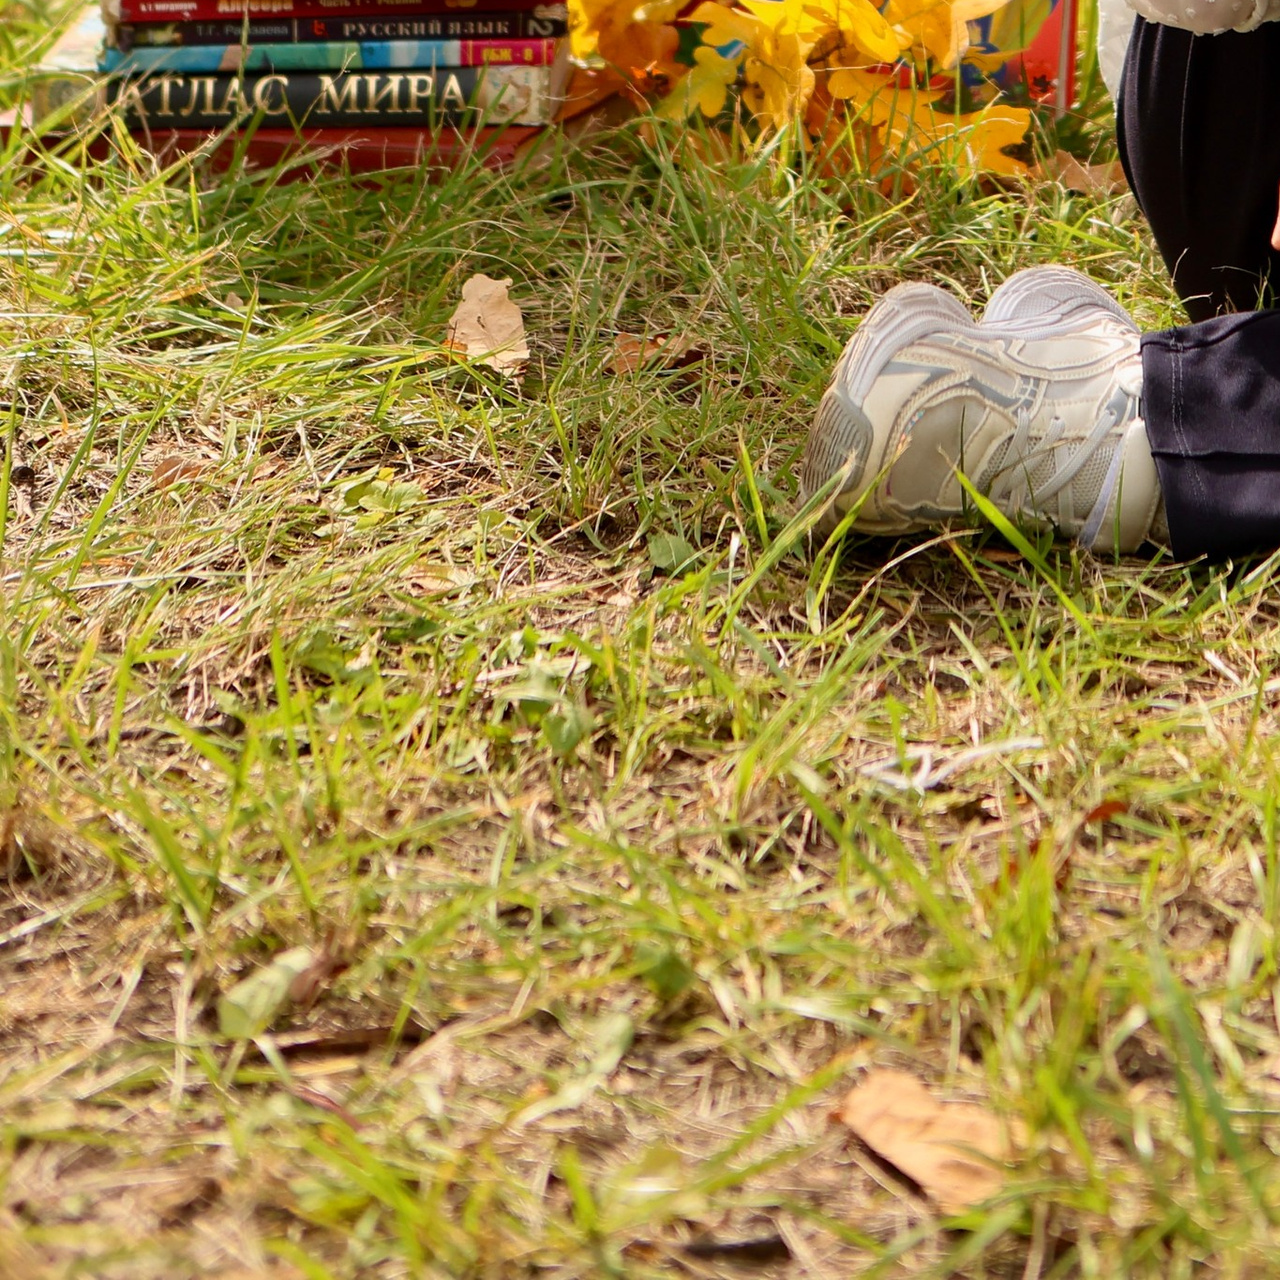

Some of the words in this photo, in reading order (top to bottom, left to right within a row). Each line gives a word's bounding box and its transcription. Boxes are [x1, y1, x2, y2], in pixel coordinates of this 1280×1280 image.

[342, 20, 442, 37] РУССКИЙ
[447, 21, 510, 34] ЯЗЫК
[316, 73, 469, 114] МИРА
